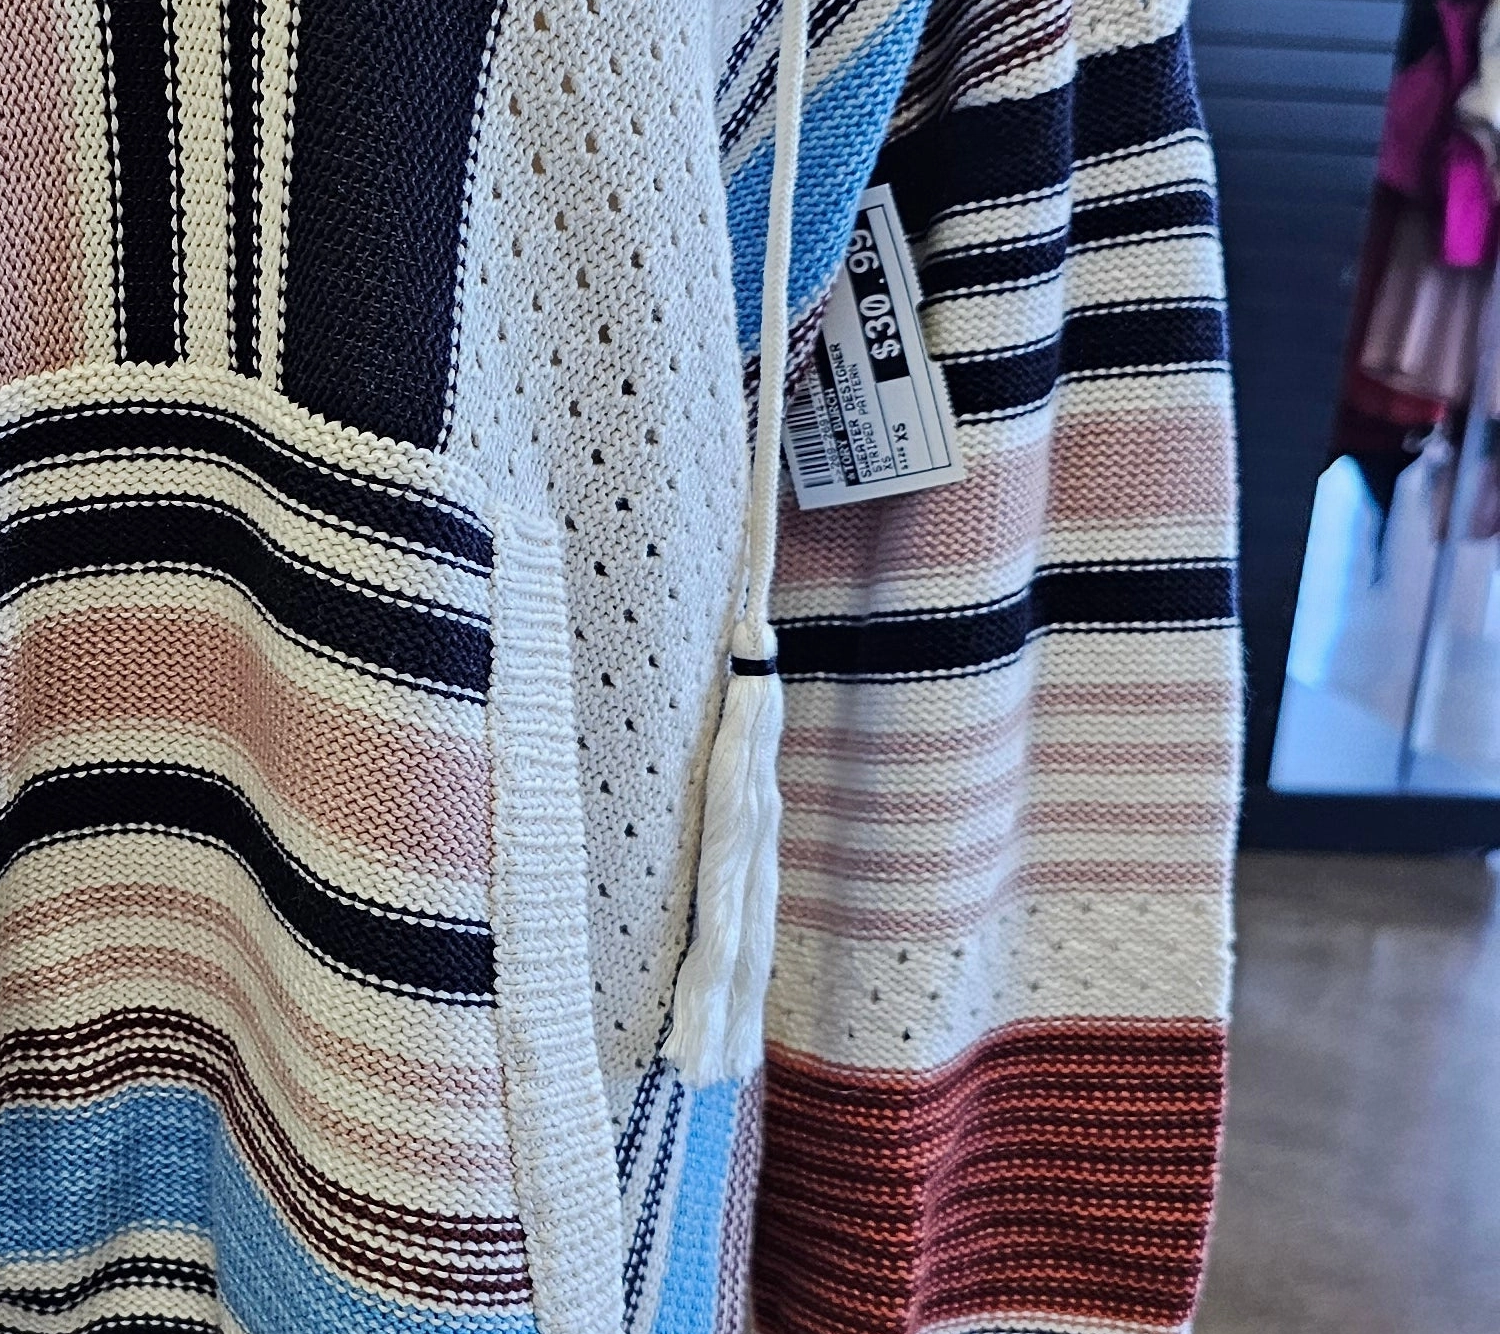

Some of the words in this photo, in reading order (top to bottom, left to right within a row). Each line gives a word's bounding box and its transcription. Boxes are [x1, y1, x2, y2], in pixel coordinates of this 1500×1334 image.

[847, 229, 901, 360] $30.99
[829, 342, 855, 412] DESIGNER
[847, 363, 868, 415] PATTERN
[824, 388, 844, 432] BURCH
[893, 422, 909, 443] XS
[848, 418, 872, 478] SWEATER
[862, 422, 882, 472] STRIPED
[881, 456, 894, 470] XS
